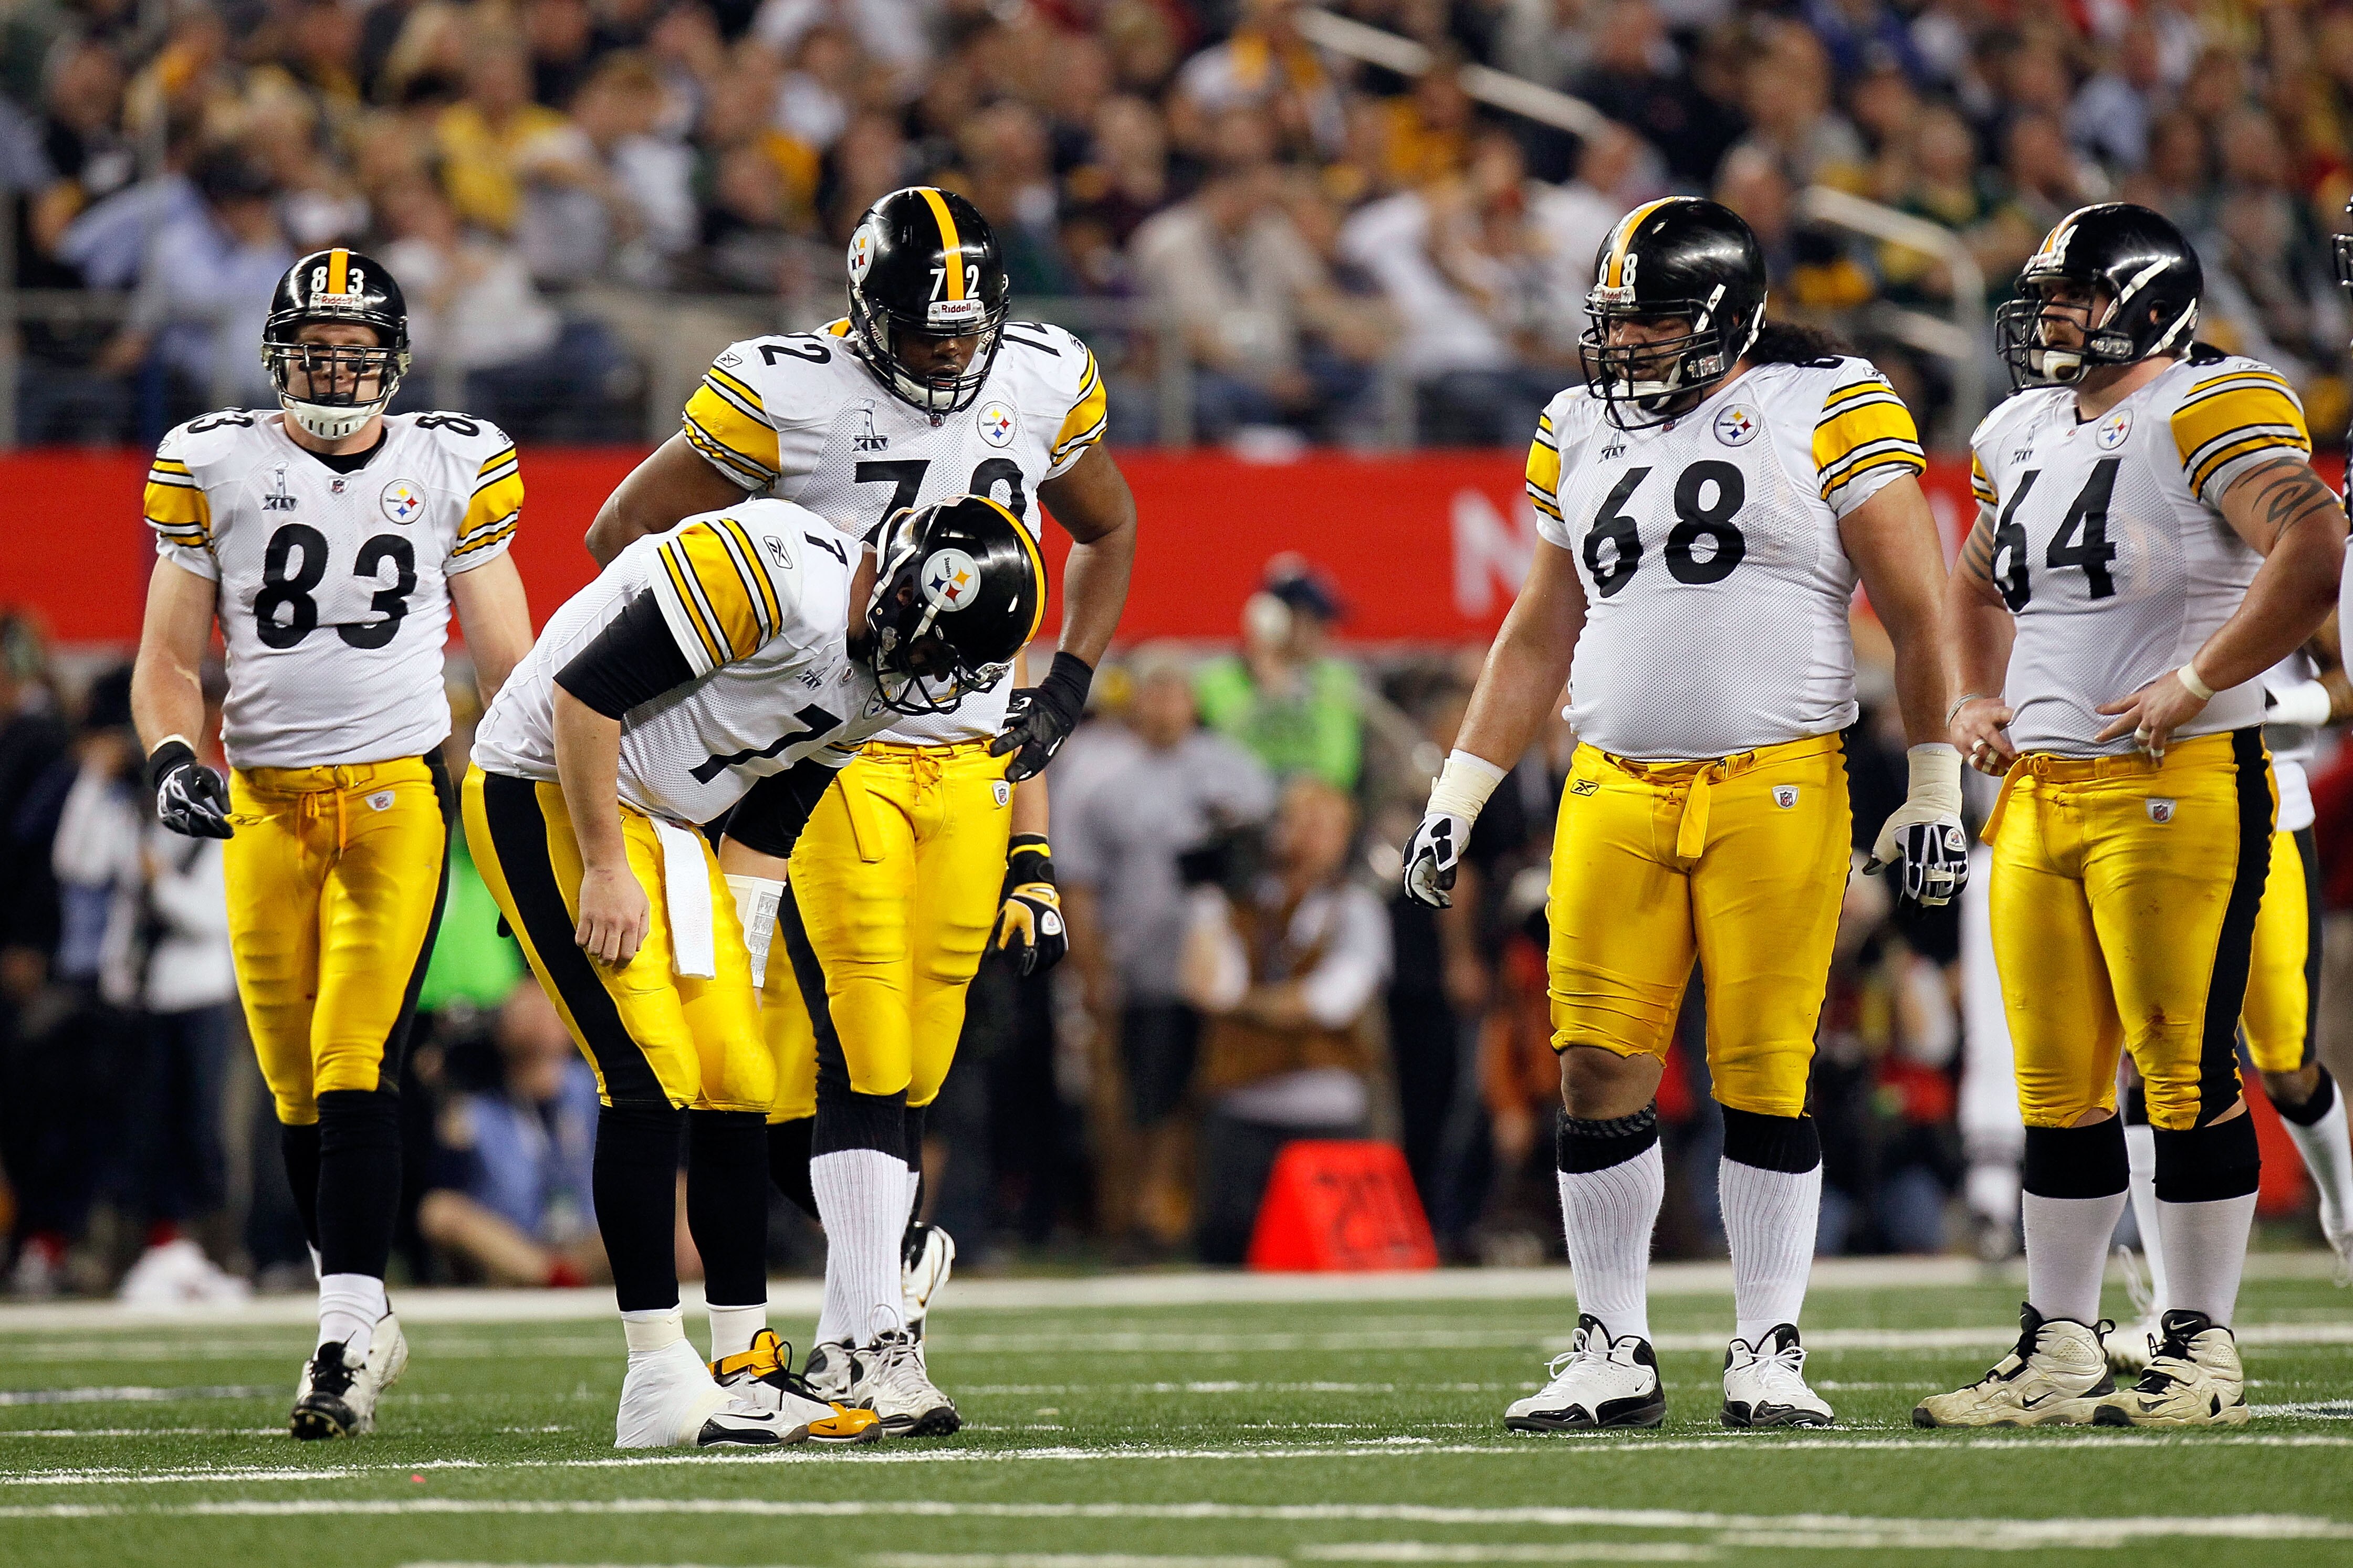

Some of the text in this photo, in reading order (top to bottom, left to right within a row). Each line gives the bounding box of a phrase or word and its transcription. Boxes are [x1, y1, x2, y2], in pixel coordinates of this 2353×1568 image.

[310, 266, 364, 294] 83
[929, 265, 979, 301] 72
[1599, 252, 1638, 285] 68
[942, 303, 971, 313] Riddell
[851, 437, 892, 452] XLV
[262, 496, 299, 510] XLV
[1582, 460, 1746, 598] 68
[1992, 458, 2122, 613] 64
[254, 522, 418, 649] 83
[688, 703, 843, 785] 7
